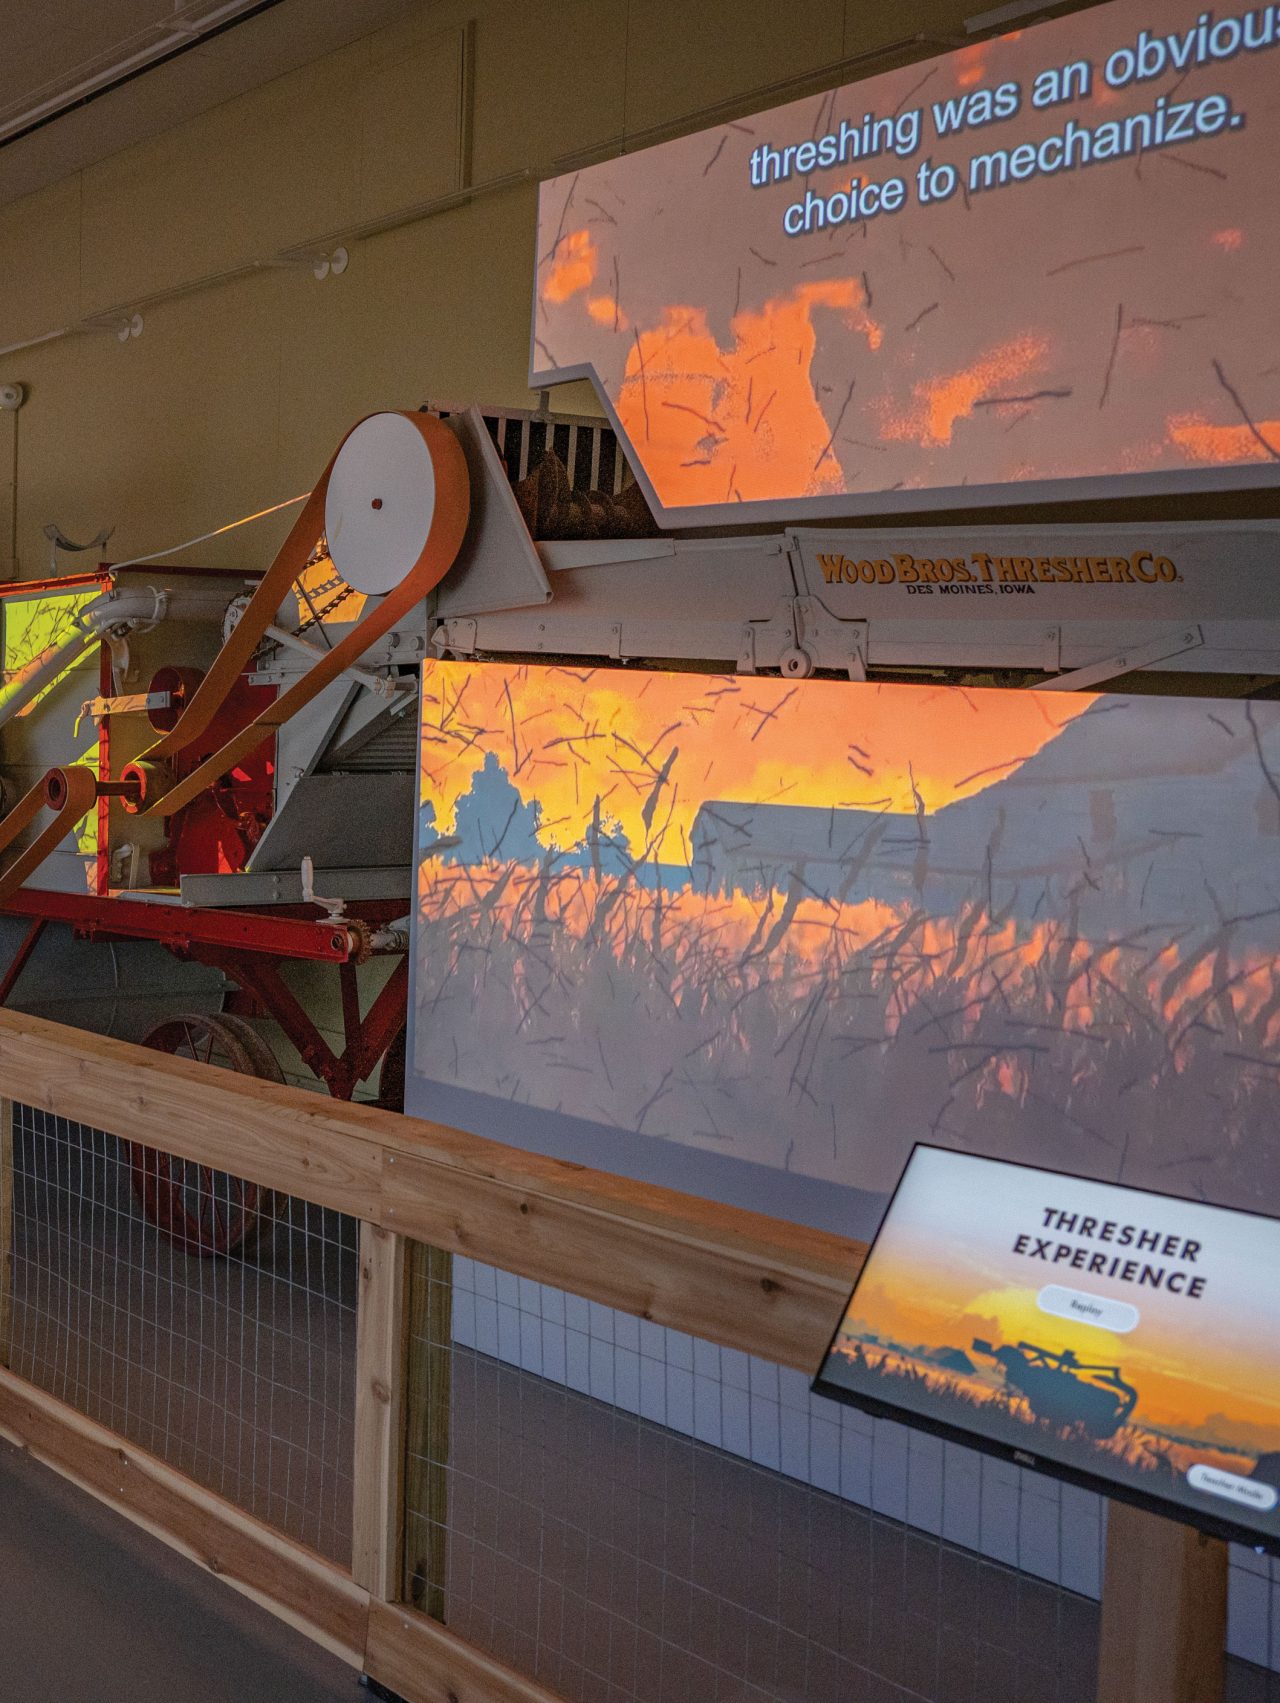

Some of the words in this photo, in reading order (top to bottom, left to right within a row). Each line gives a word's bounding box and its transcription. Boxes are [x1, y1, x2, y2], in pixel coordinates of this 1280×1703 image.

[749, 110, 920, 186] threshing
[931, 81, 1019, 134] was
[1031, 60, 1089, 107] an
[1104, 5, 1280, 86] obviou
[783, 176, 905, 235] choice
[916, 160, 956, 202] to
[969, 94, 1241, 190] mechanize.
[815, 552, 897, 584] WOOD
[970, 552, 1137, 584] THRESHER
[906, 584, 934, 595] DES
[999, 583, 1036, 595] IOWA
[1041, 1206, 1202, 1262] THRESHER
[1012, 1233, 1207, 1299] EXPERIENCE
